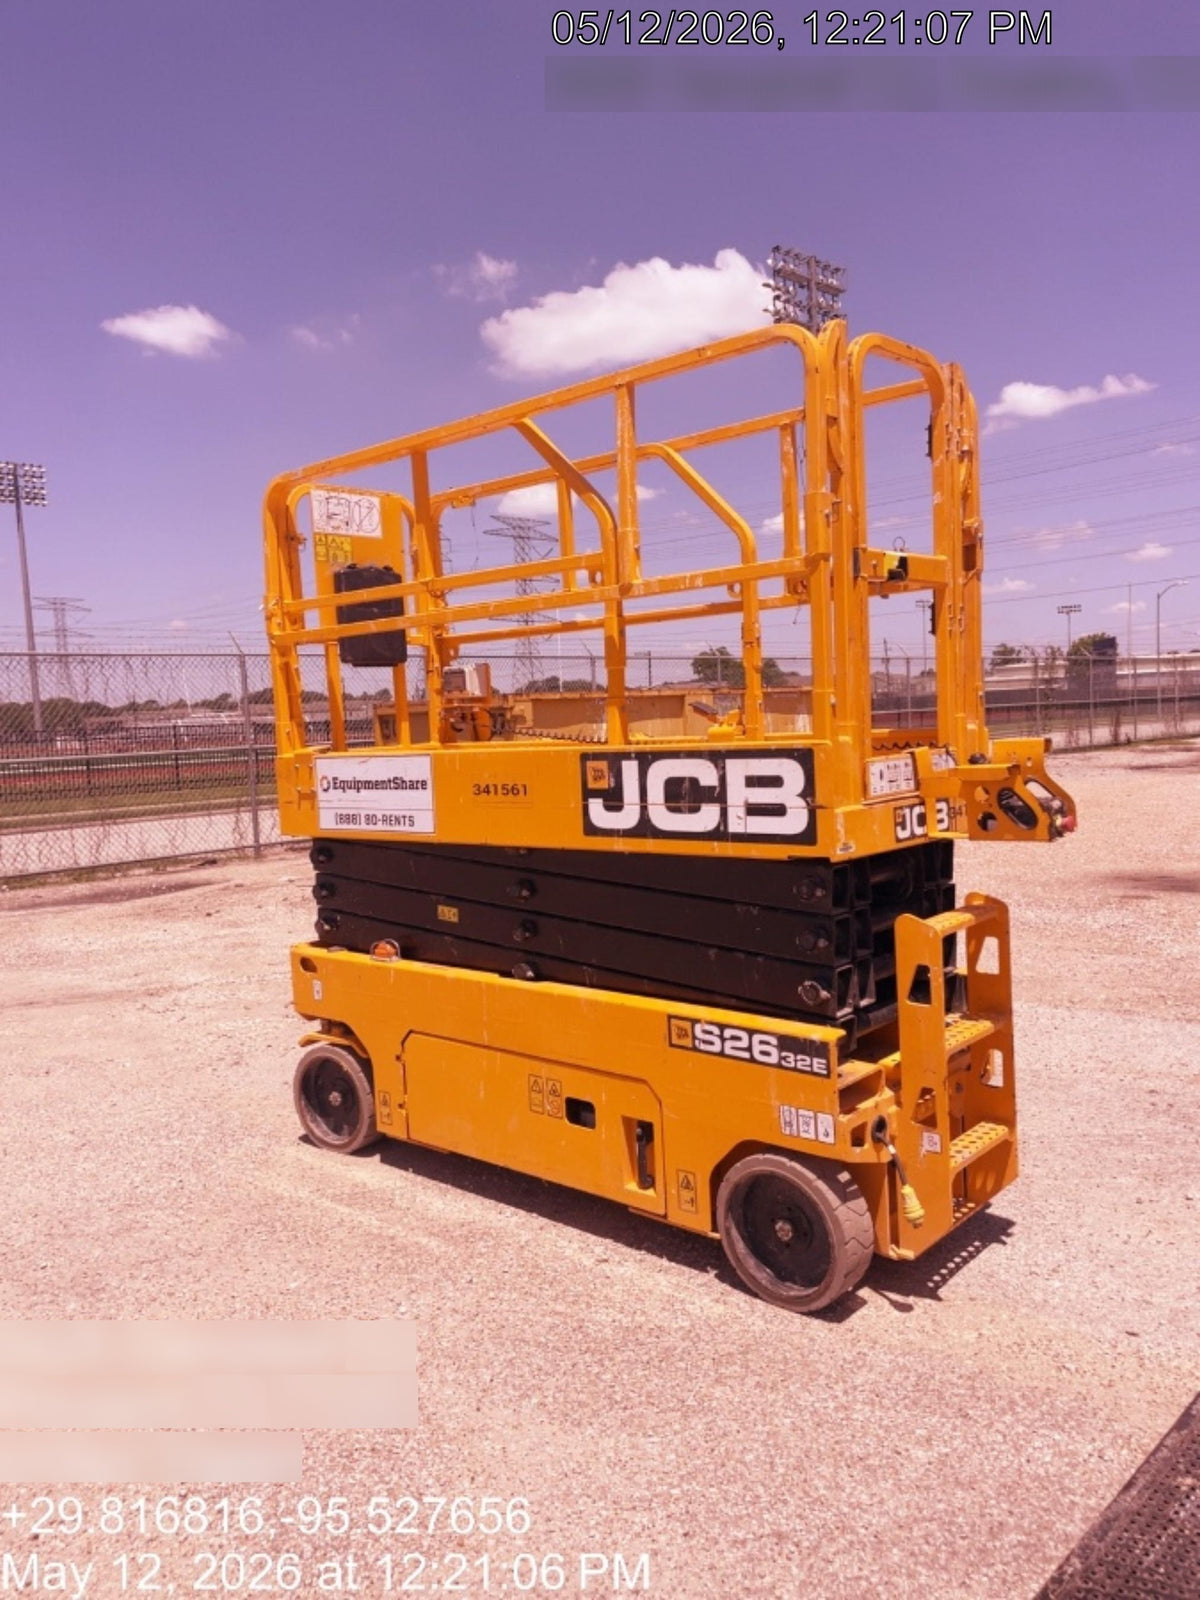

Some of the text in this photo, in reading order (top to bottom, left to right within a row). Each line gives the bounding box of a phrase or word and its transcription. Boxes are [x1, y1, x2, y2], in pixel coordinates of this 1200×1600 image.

[331, 776, 428, 793] EquipmentShare
[472, 784, 528, 796] 341561
[588, 758, 809, 835] JCB
[364, 813, 415, 827] 80-RENTS
